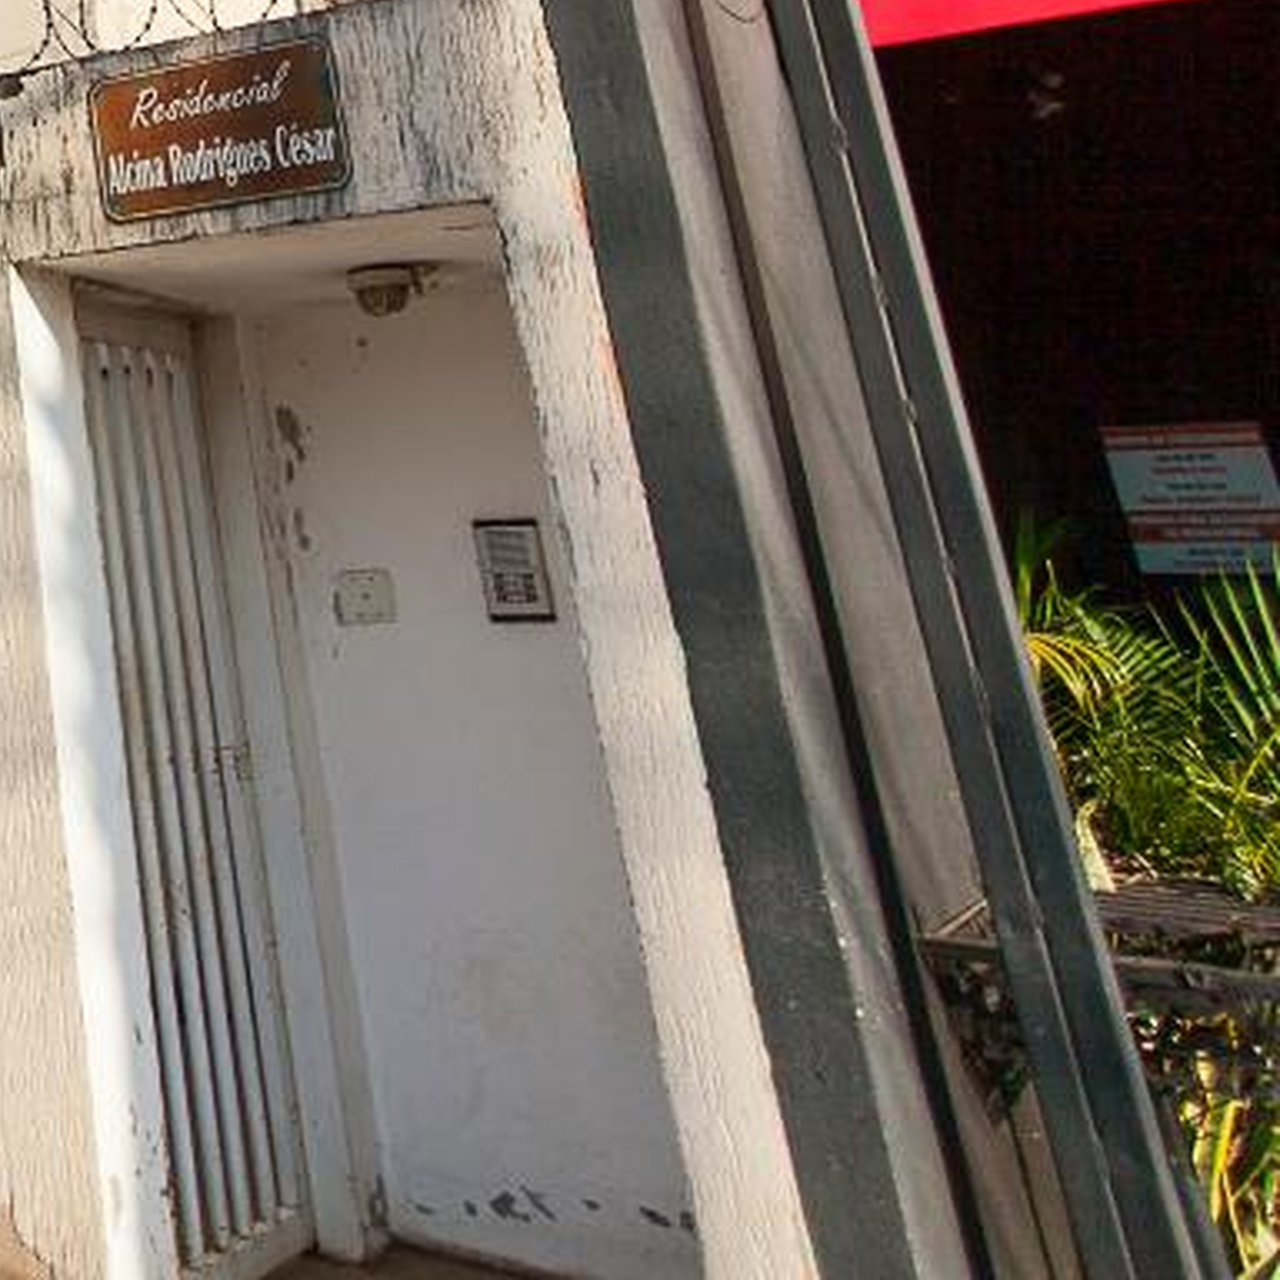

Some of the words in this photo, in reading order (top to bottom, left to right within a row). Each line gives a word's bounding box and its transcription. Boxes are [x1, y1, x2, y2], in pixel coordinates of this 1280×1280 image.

[130, 60, 290, 128] Residencial
[168, 136, 271, 187] Rodrigues
[274, 123, 336, 167] César
